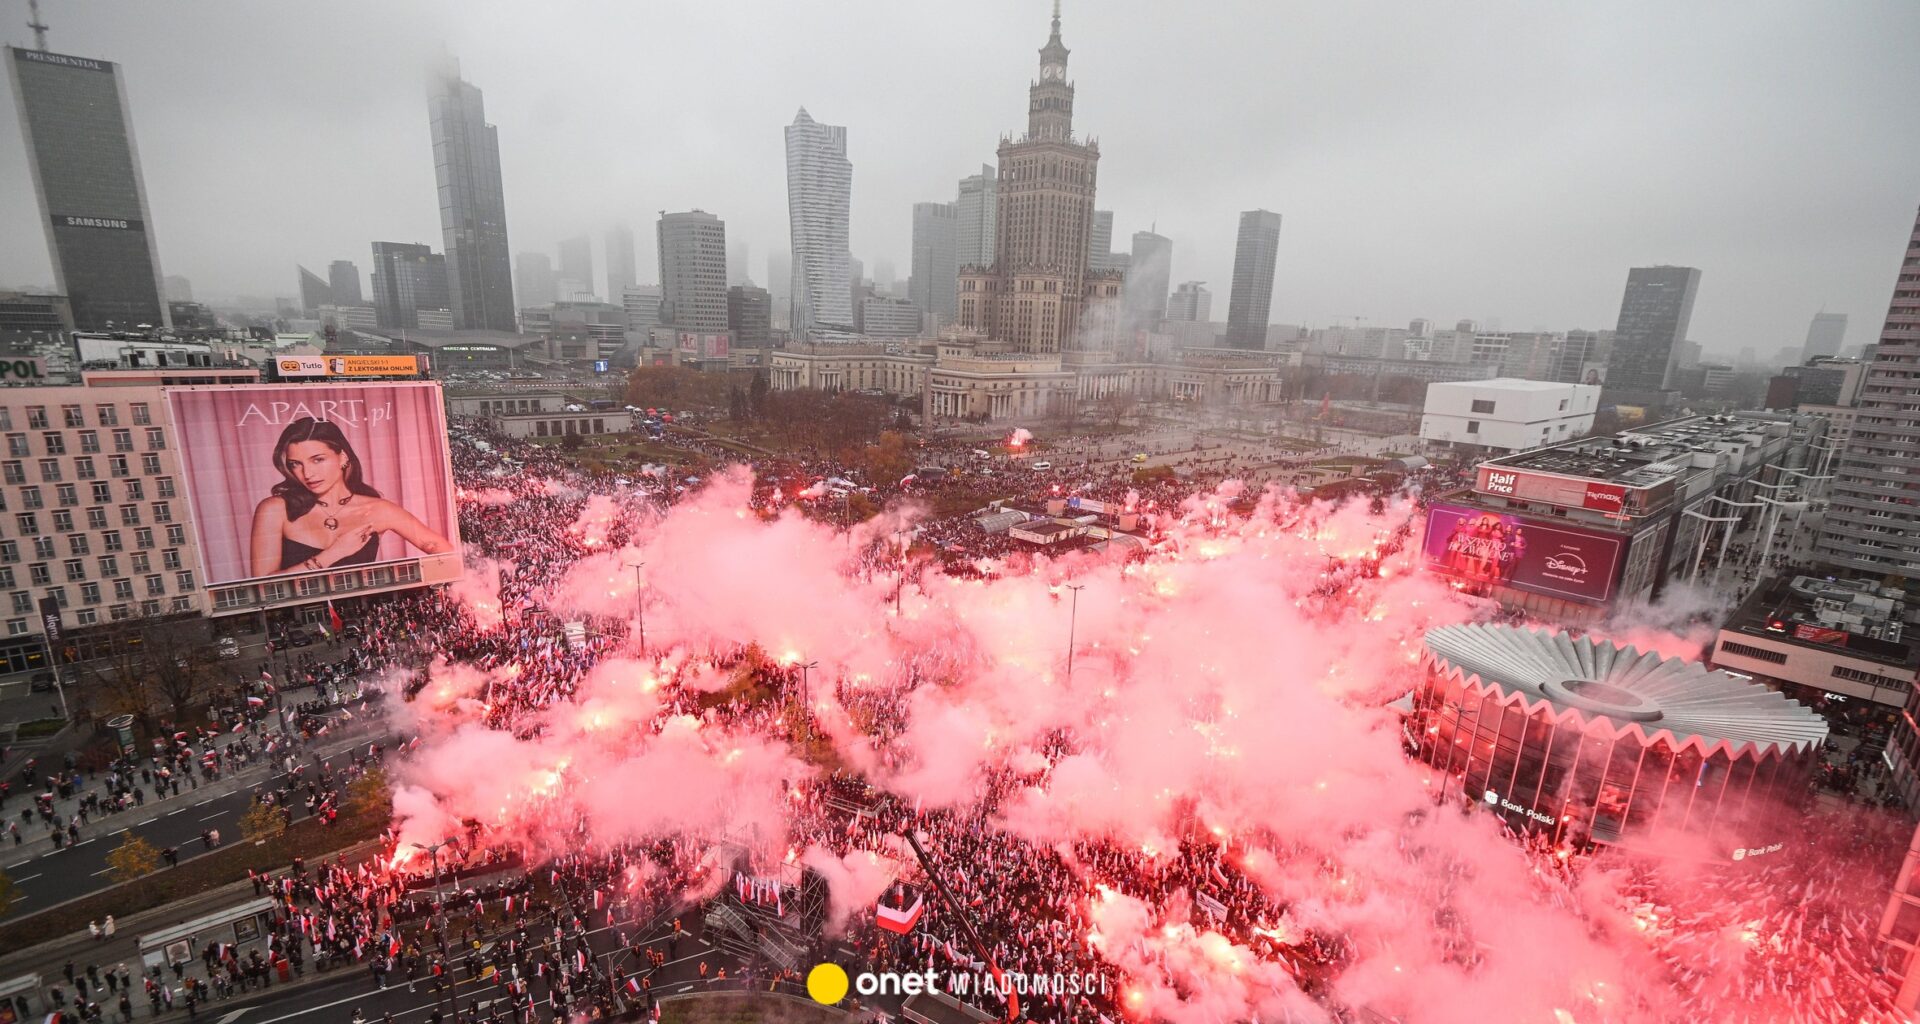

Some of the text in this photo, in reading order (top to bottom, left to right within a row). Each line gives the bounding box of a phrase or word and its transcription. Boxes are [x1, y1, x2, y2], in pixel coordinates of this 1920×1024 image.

[25, 51, 102, 70] PRESIDENTIAL
[66, 216, 128, 229] SAMSUNG
[1489, 472, 1516, 485] Half
[1487, 482, 1513, 494] Price
[1824, 692, 1847, 702] KFC
[1501, 798, 1556, 826] Bank Polski
[1748, 847, 1765, 856] Bank
